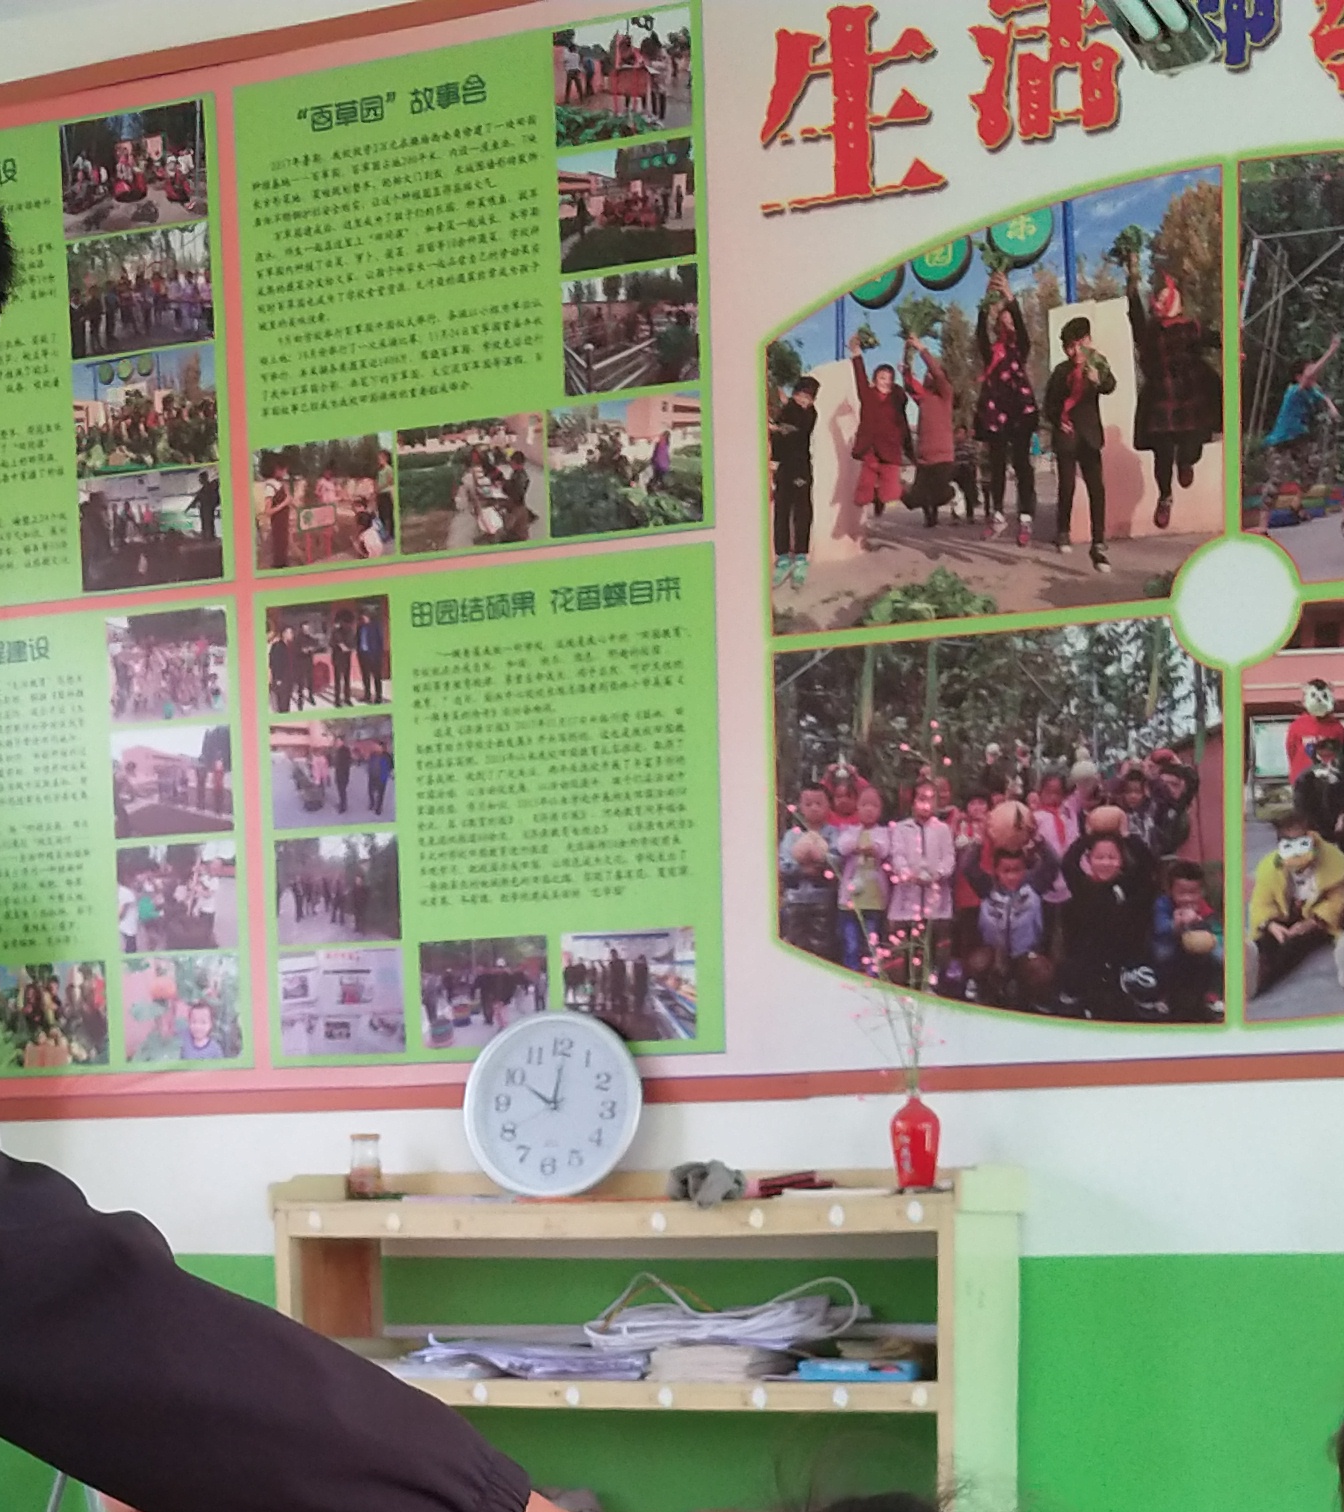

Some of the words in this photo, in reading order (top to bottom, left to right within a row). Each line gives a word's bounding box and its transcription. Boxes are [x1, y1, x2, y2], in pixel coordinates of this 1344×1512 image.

[409, 73, 487, 115] 故事会
[410, 589, 537, 629] 田园结硕果
[526, 1046, 544, 1066] 11
[552, 1037, 574, 1058] 12
[584, 1049, 592, 1068] 1
[506, 1067, 526, 1087] 10
[595, 1072, 612, 1091] 2
[494, 1094, 511, 1112] 9
[598, 1100, 616, 1120] 3
[500, 1121, 517, 1142] 8
[588, 1127, 603, 1147] 4
[515, 1144, 532, 1164] 7
[567, 1149, 584, 1167] 5
[540, 1157, 556, 1176] 6
